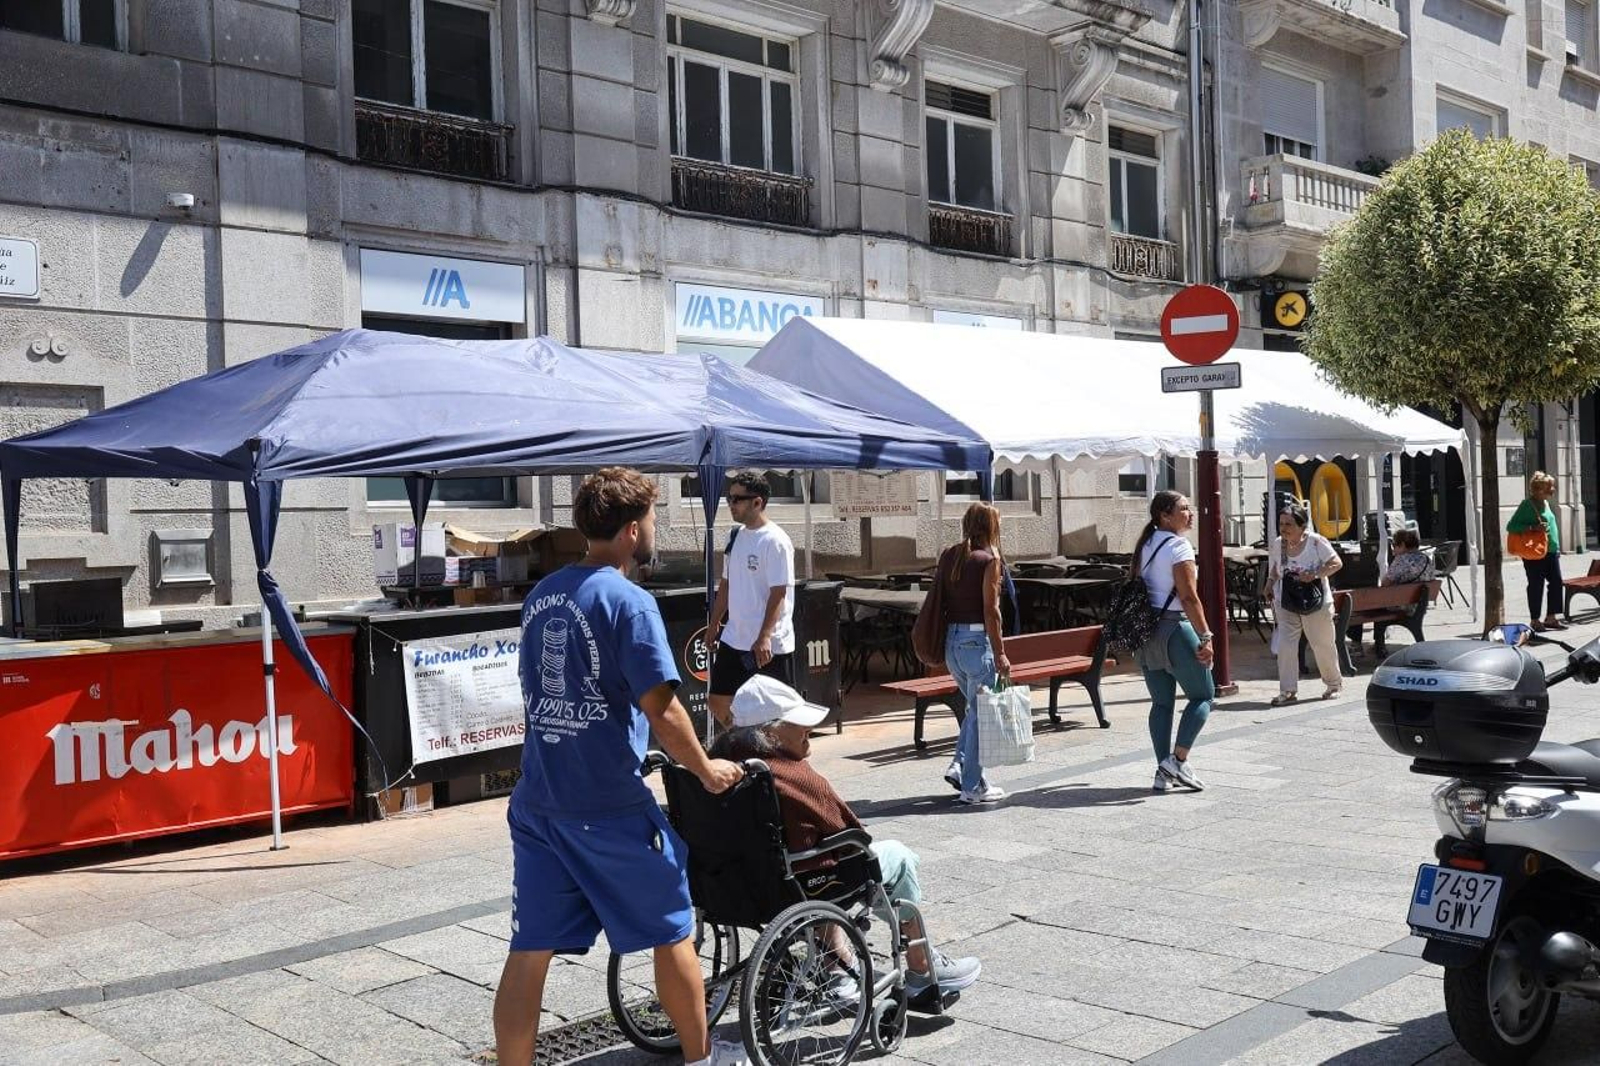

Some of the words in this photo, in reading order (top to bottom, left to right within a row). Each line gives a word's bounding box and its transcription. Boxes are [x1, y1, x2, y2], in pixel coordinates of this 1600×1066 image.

[1167, 374, 1200, 385] EXCEPTO
[414, 643, 489, 667] Furancho
[494, 640, 521, 659] Xo
[1396, 676, 1438, 687] SHAD
[46, 708, 299, 786] Mahou
[460, 723, 526, 746] RESERVAS
[808, 875, 827, 887] ERGO
[1434, 871, 1497, 903] 7497
[1436, 899, 1482, 929] GWY
